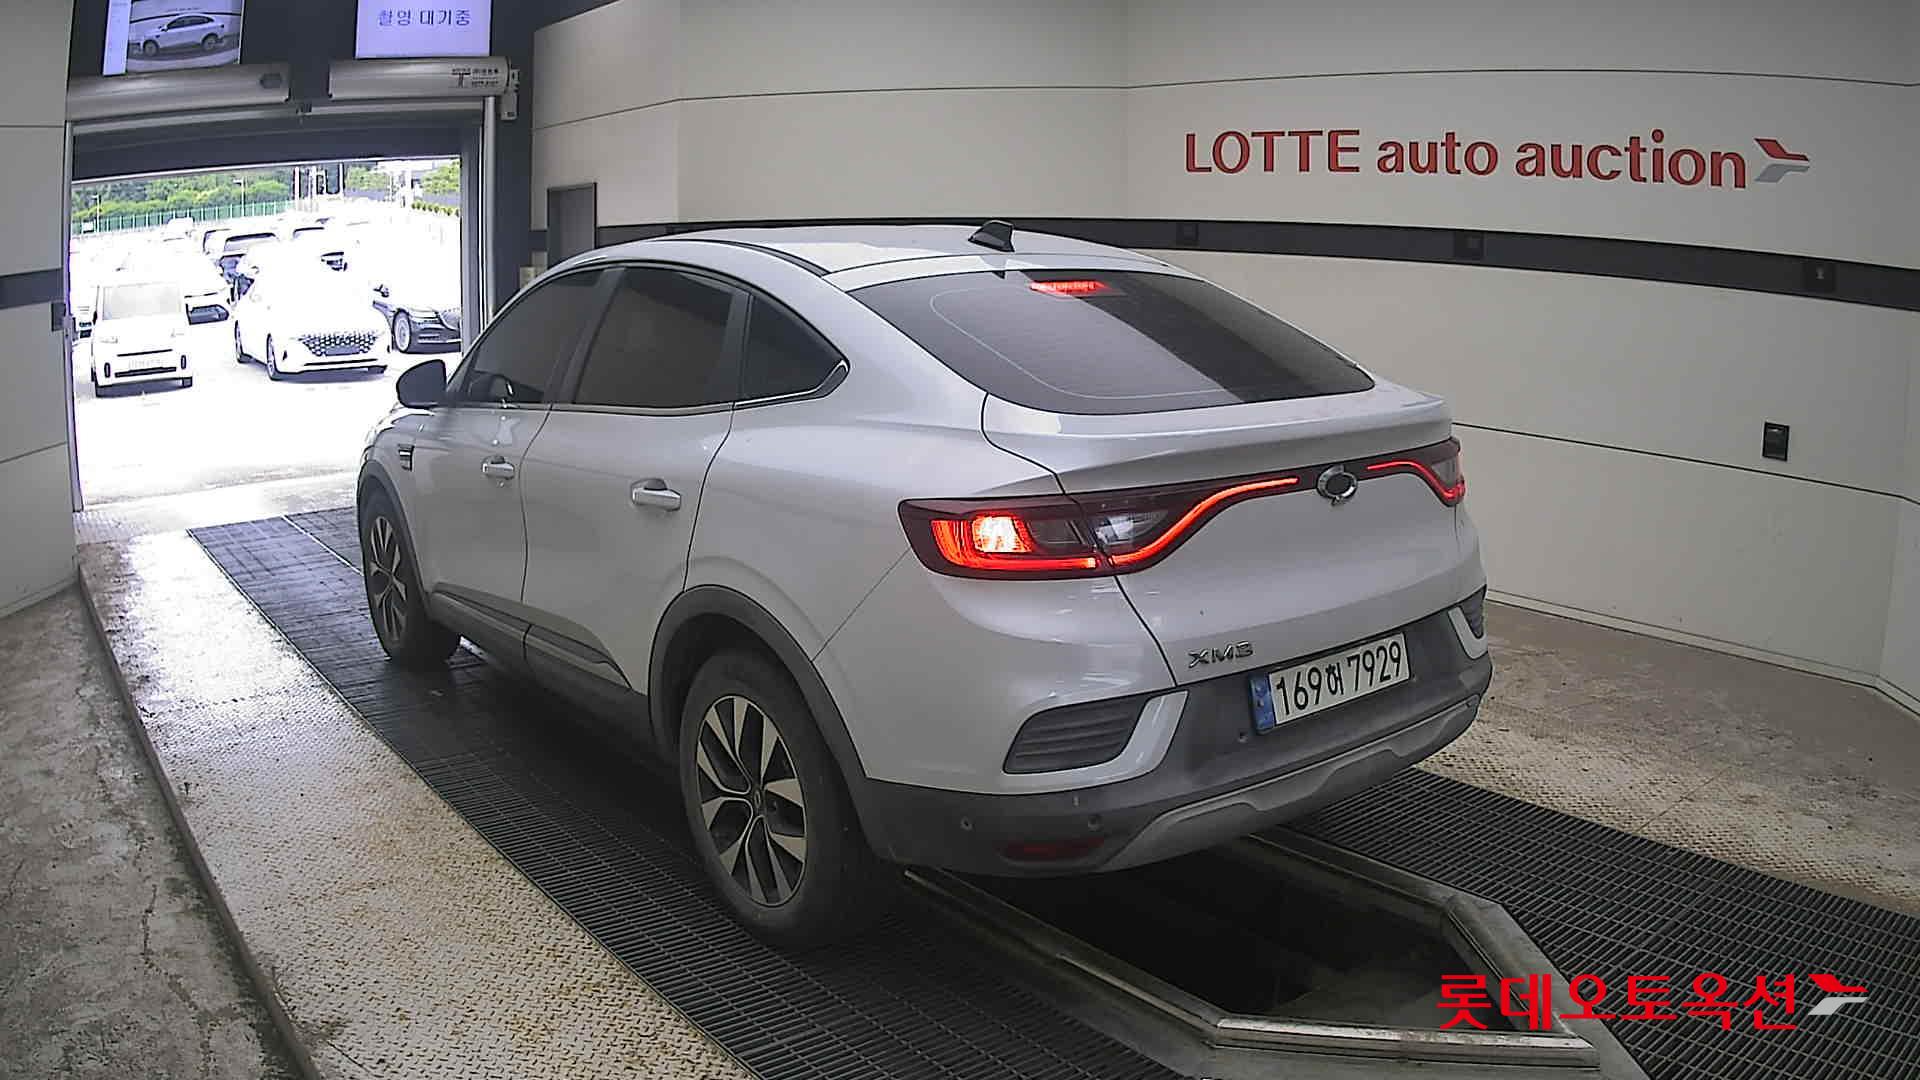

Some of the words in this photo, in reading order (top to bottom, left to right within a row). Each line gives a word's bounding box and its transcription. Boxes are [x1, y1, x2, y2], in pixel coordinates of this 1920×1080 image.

[420, 9, 470, 26] 대기중
[1185, 129, 1360, 173] LOTTE
[1376, 132, 1498, 176] auto
[1515, 129, 1747, 188] auction
[1188, 641, 1253, 668] XM3
